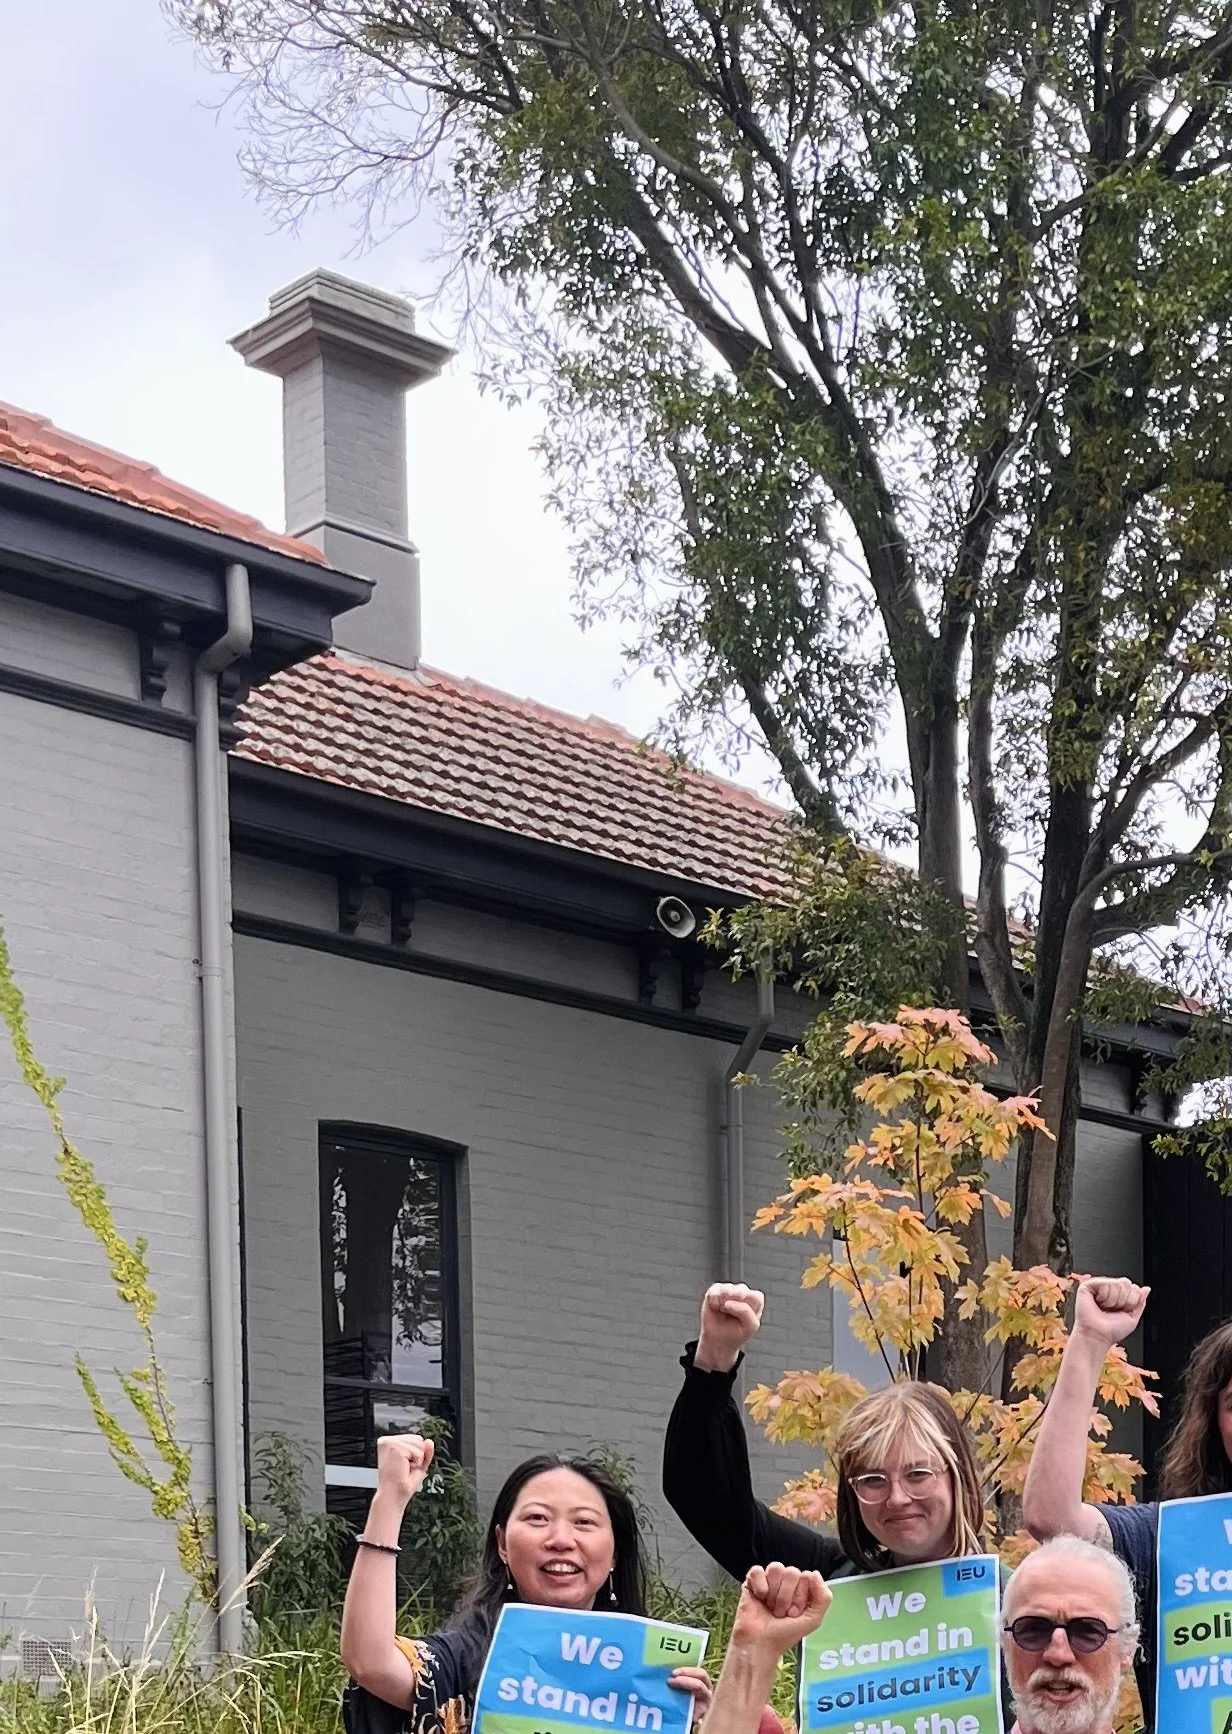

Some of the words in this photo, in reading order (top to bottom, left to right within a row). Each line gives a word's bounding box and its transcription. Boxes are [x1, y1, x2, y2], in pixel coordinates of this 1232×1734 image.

[957, 1568, 984, 1580] IEU
[867, 1591, 926, 1620] We
[562, 1633, 622, 1669] We
[660, 1638, 691, 1653] IEU
[819, 1629, 928, 1670] stand
[937, 1622, 972, 1651] in
[499, 1677, 616, 1721] stand
[626, 1695, 661, 1730] in
[817, 1665, 981, 1712] solidarity
